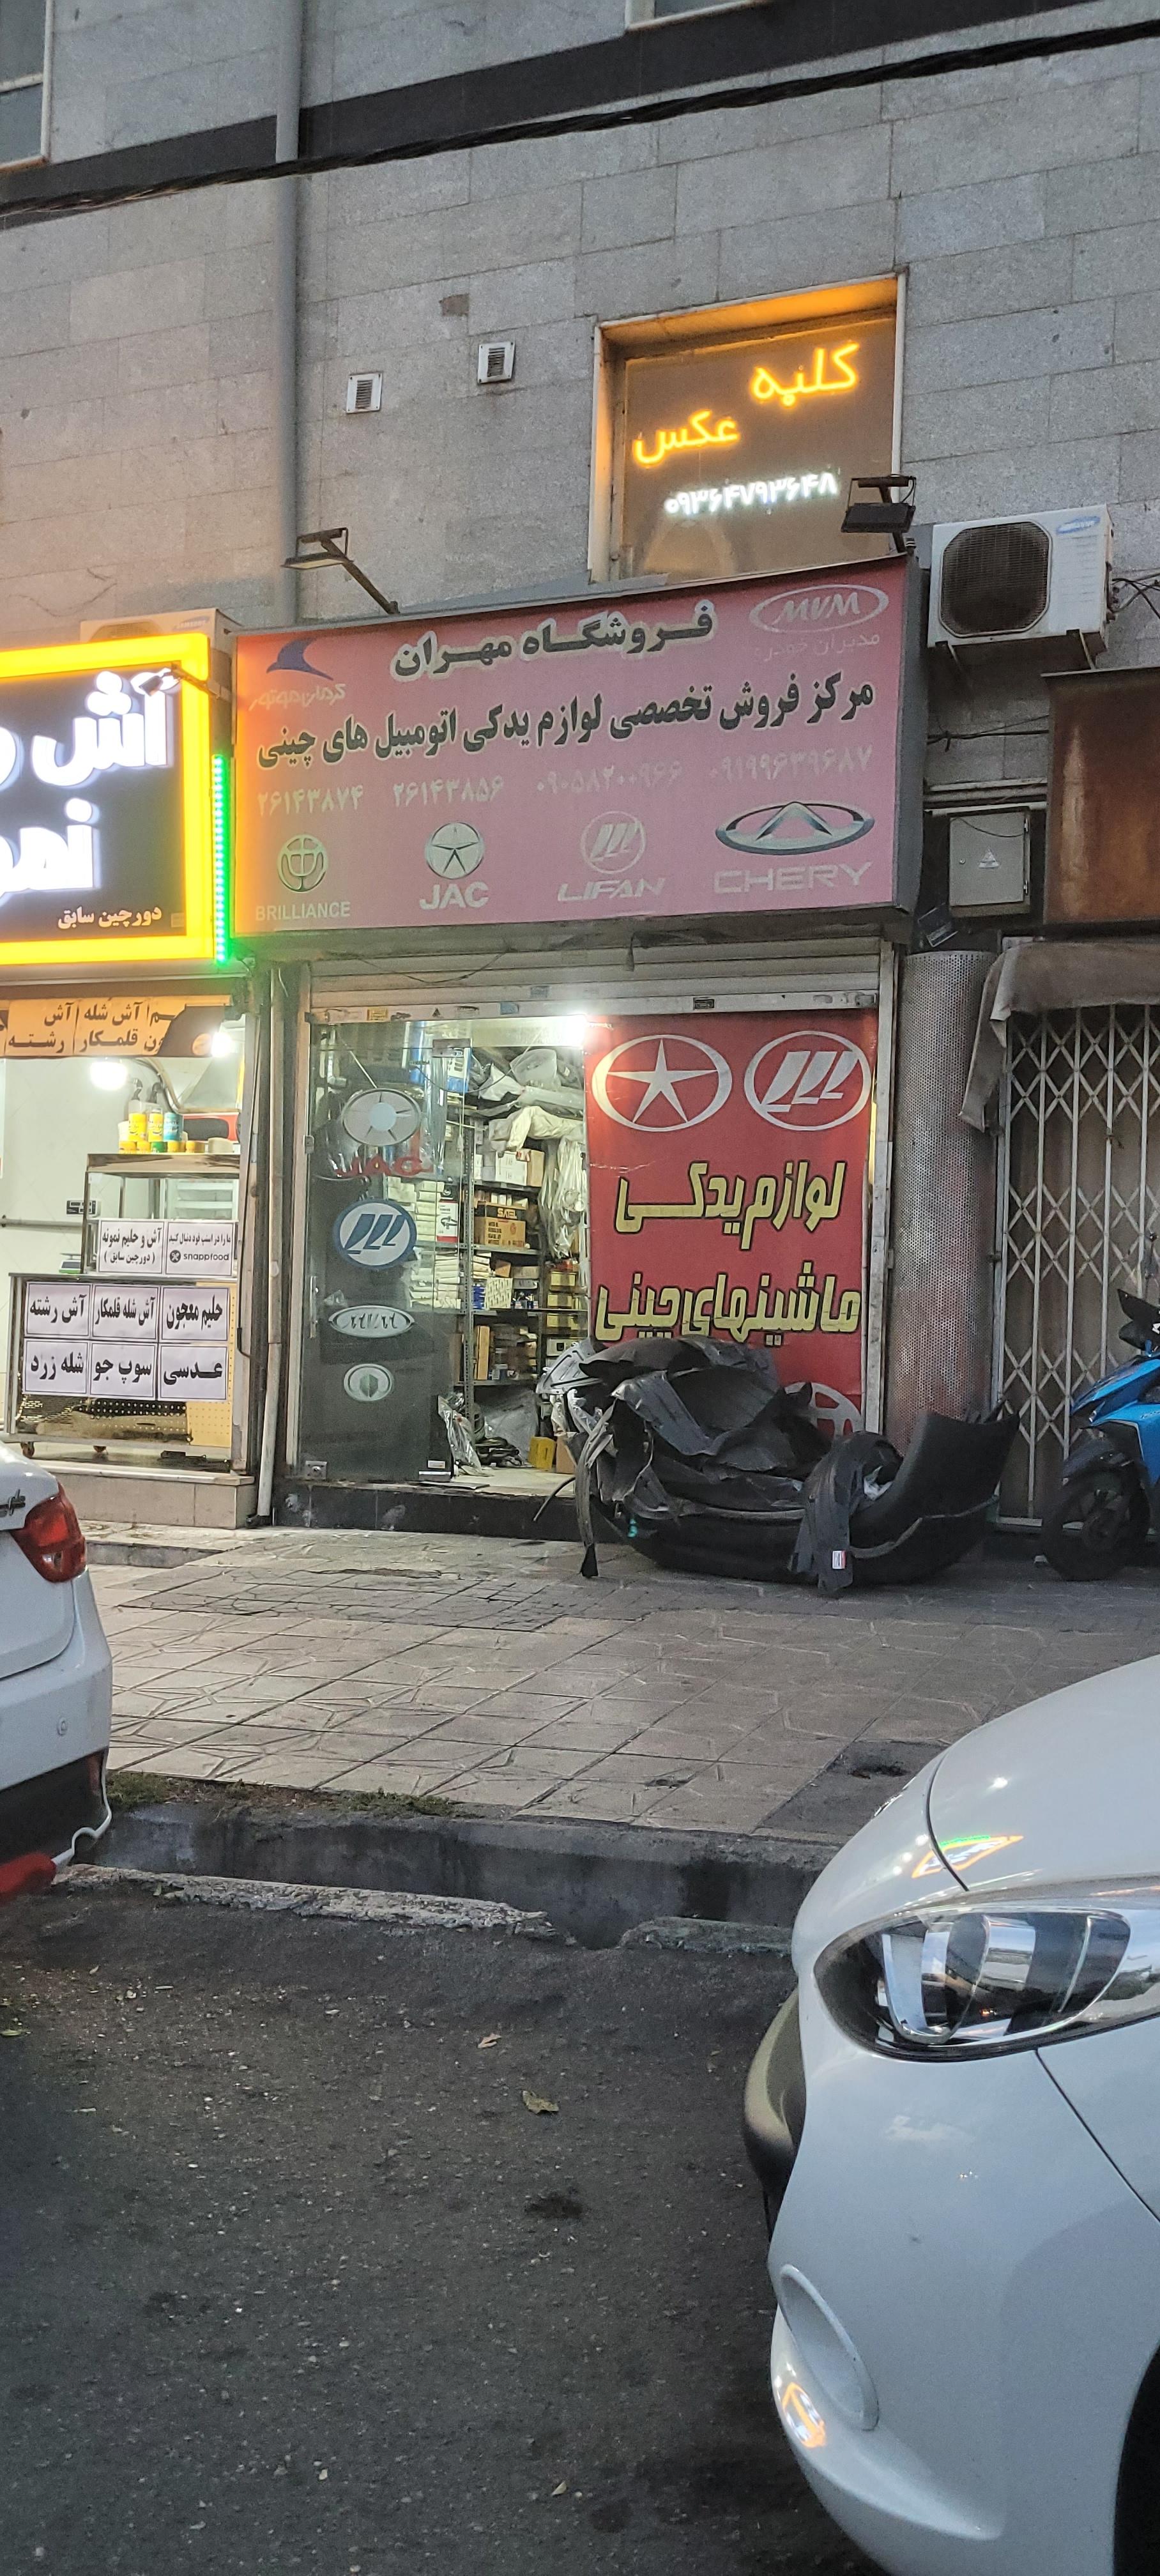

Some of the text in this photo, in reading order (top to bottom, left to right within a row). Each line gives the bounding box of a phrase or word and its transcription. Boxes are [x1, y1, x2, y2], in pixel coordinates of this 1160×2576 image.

[750, 341, 860, 406] کلبه
[632, 410, 741, 466] عکس
[772, 592, 861, 624] MVM
[392, 599, 715, 678] فروشگاه مهران
[32, 668, 181, 786] آش
[258, 671, 874, 768] مرکز فروش تخصصی لوازم یدکی اتومبیل های چینی
[556, 878, 666, 901] LIFAN
[713, 861, 873, 894] CHERY
[419, 882, 489, 910] JAC
[57, 906, 95, 930] سابق
[256, 901, 351, 921] BRILLIANCE
[44, 1002, 74, 1027] آش
[84, 1004, 108, 1021] شله
[112, 1002, 143, 1026] آش
[8, 1031, 65, 1054] رشته
[80, 1029, 139, 1053] قلمکار
[614, 1160, 848, 1251] لوازم یدکی
[102, 1227, 162, 1248] آش و حلیم نمونه
[183, 1253, 229, 1262] snappfood
[30, 1294, 87, 1324] آش رشته
[95, 1296, 155, 1326] آش شله قلمکار
[166, 1294, 223, 1331] حلیم معجون
[595, 1272, 681, 1342] چینی
[31, 1351, 84, 1381] شله زرد
[93, 1359, 152, 1384] سوپ جو
[164, 1361, 222, 1385] عدسی
